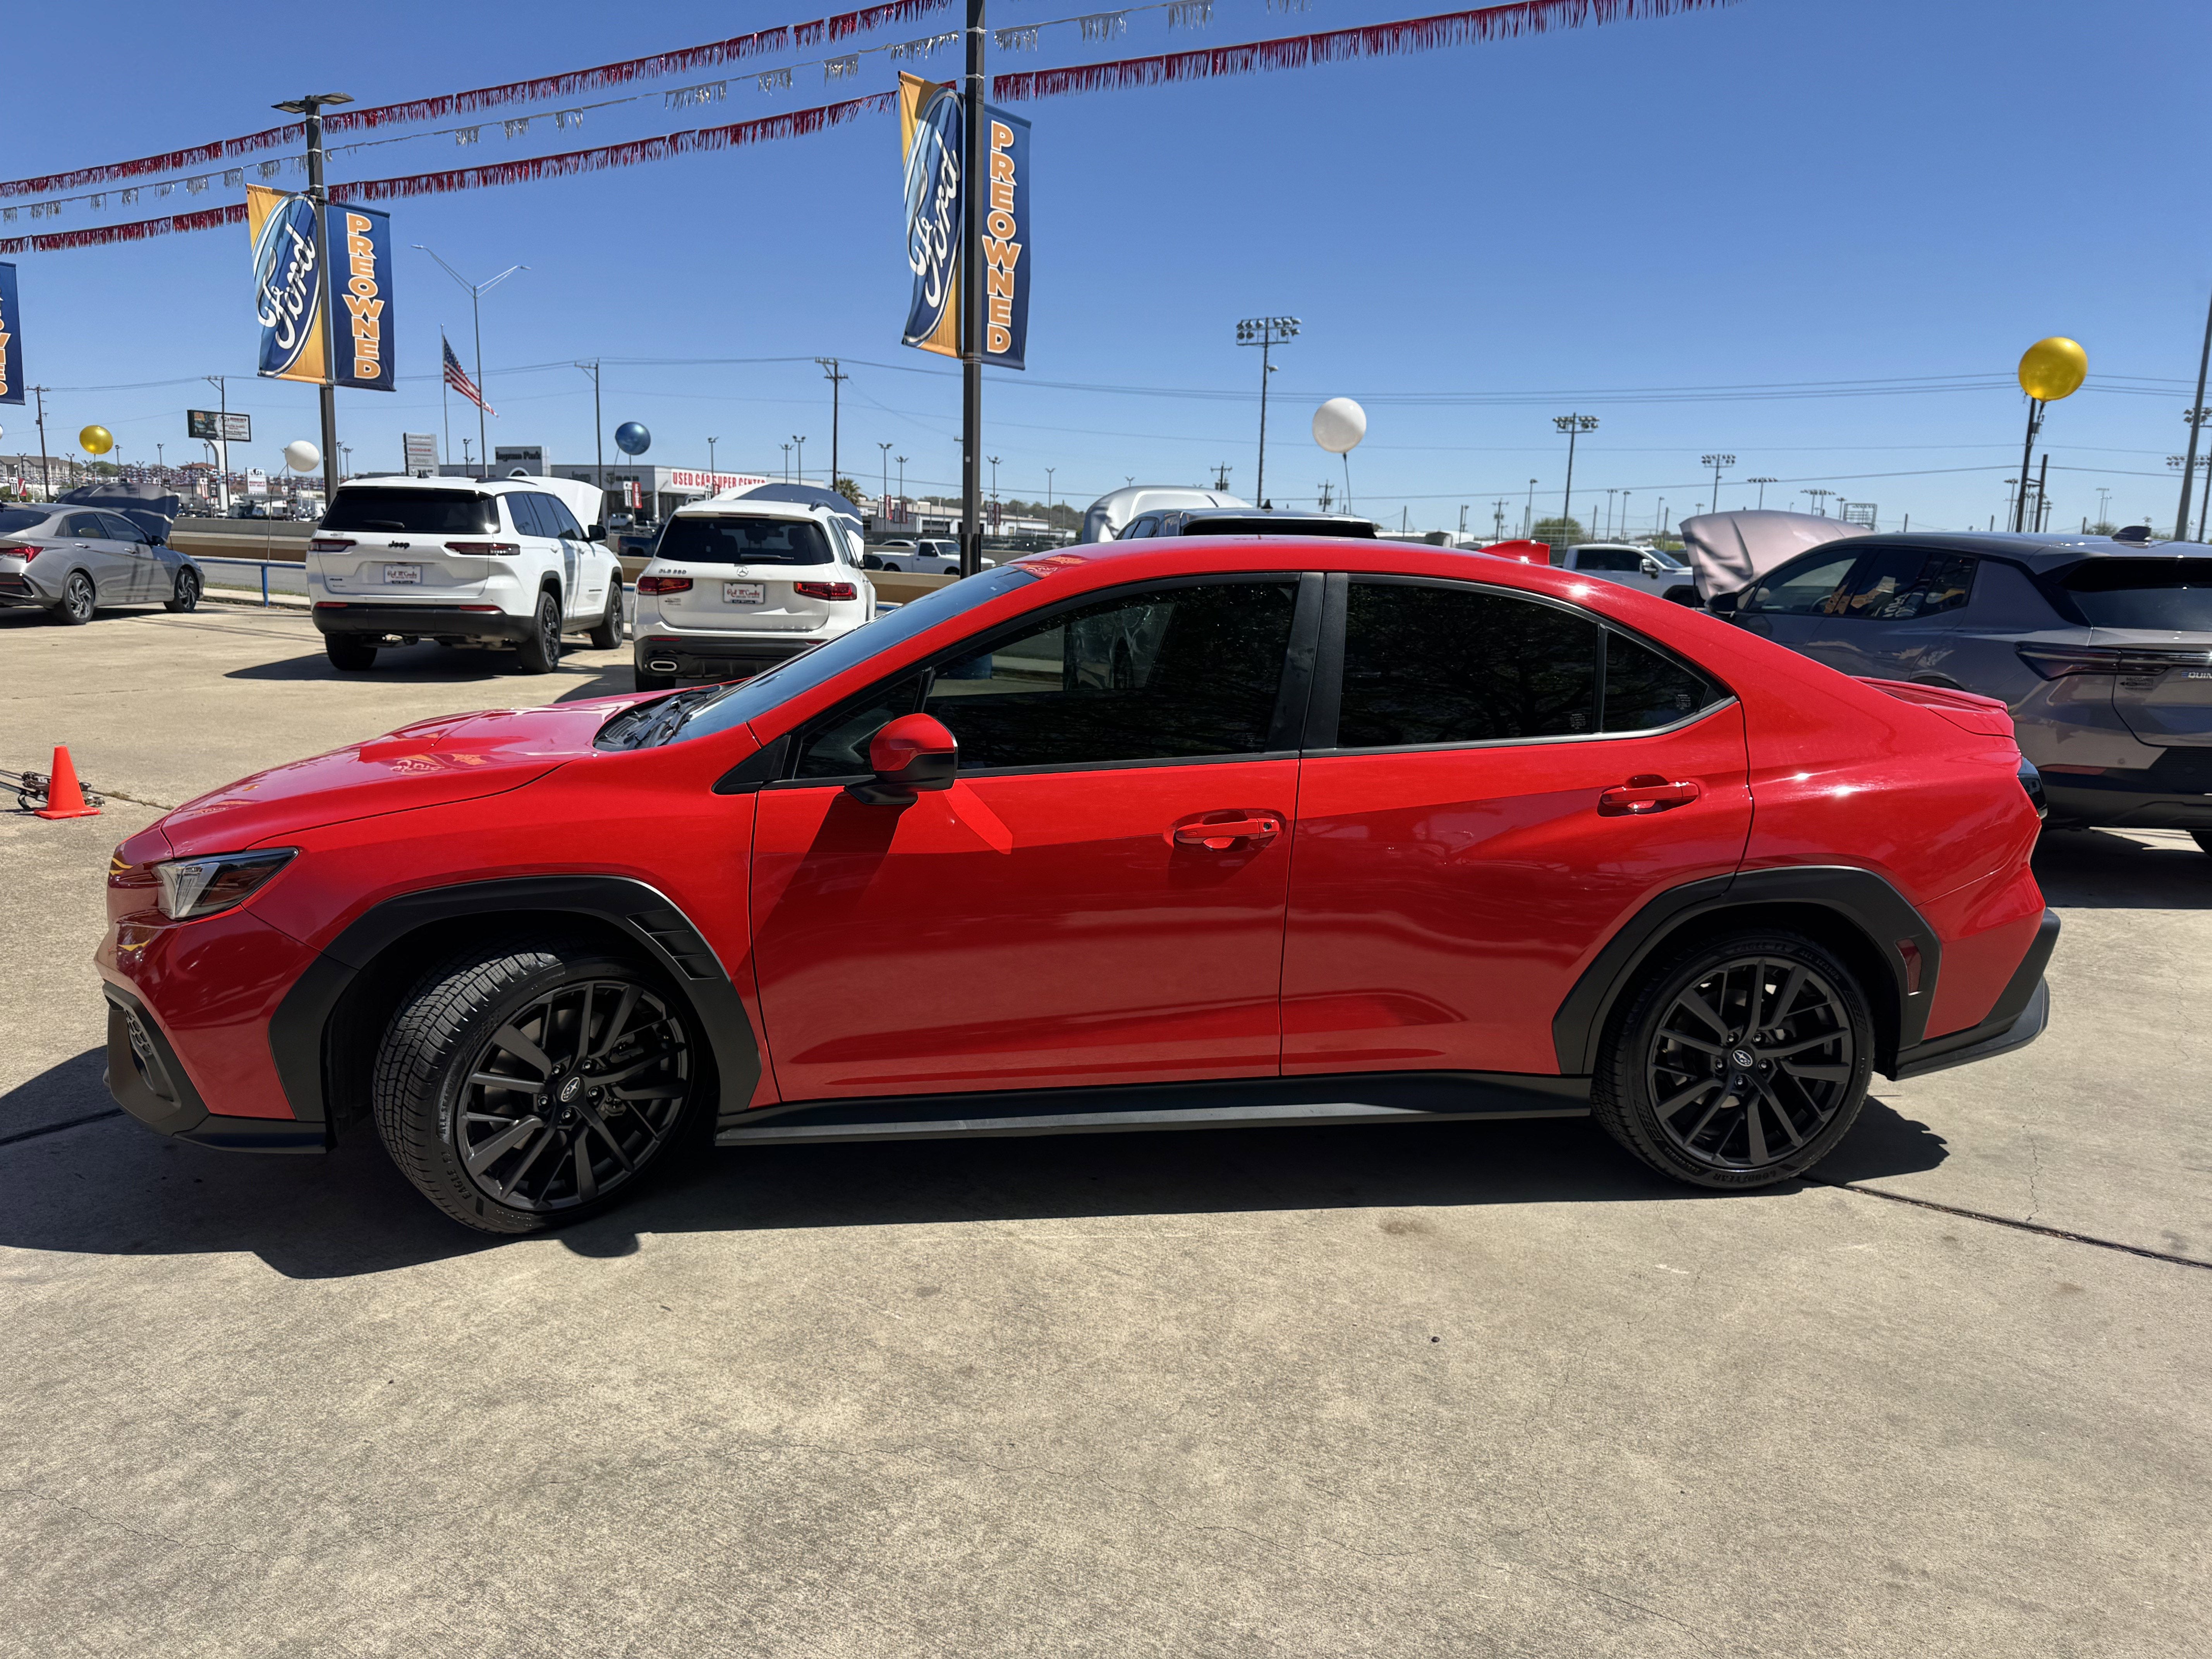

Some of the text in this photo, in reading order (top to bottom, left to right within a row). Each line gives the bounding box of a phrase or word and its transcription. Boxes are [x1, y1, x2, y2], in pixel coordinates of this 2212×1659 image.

[907, 129, 960, 308] Ford
[982, 119, 1022, 354] PREOWNED
[258, 222, 316, 350] Ford
[342, 212, 385, 380] PREOWNED
[496, 451, 541, 462] Ingram Park
[673, 472, 693, 486] USED
[713, 475, 737, 489] SUPER
[388, 540, 410, 549] Jeep
[446, 1168, 472, 1199] EAGLE
